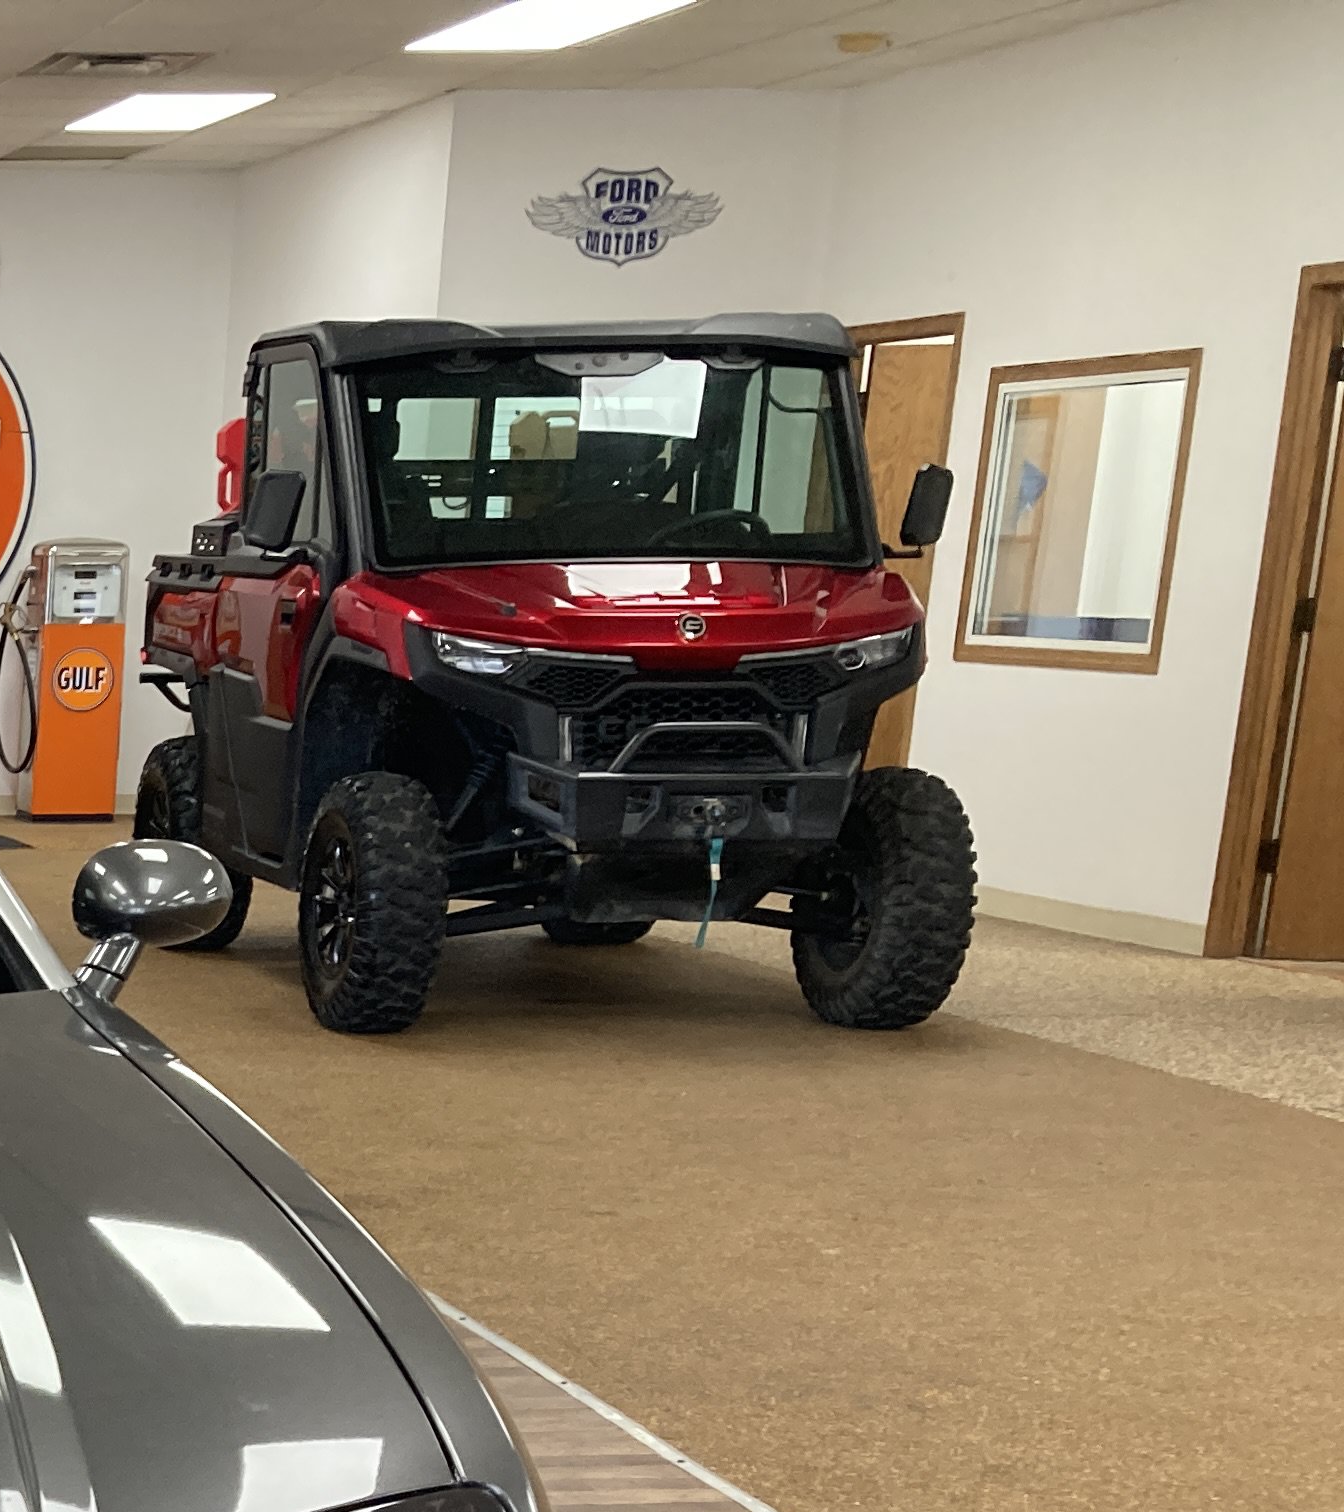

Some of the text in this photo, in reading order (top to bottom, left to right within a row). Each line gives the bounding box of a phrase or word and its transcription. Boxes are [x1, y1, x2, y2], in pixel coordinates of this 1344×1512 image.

[594, 178, 660, 203] FORD
[585, 229, 659, 256] MOTORS
[57, 667, 107, 693] GULF
